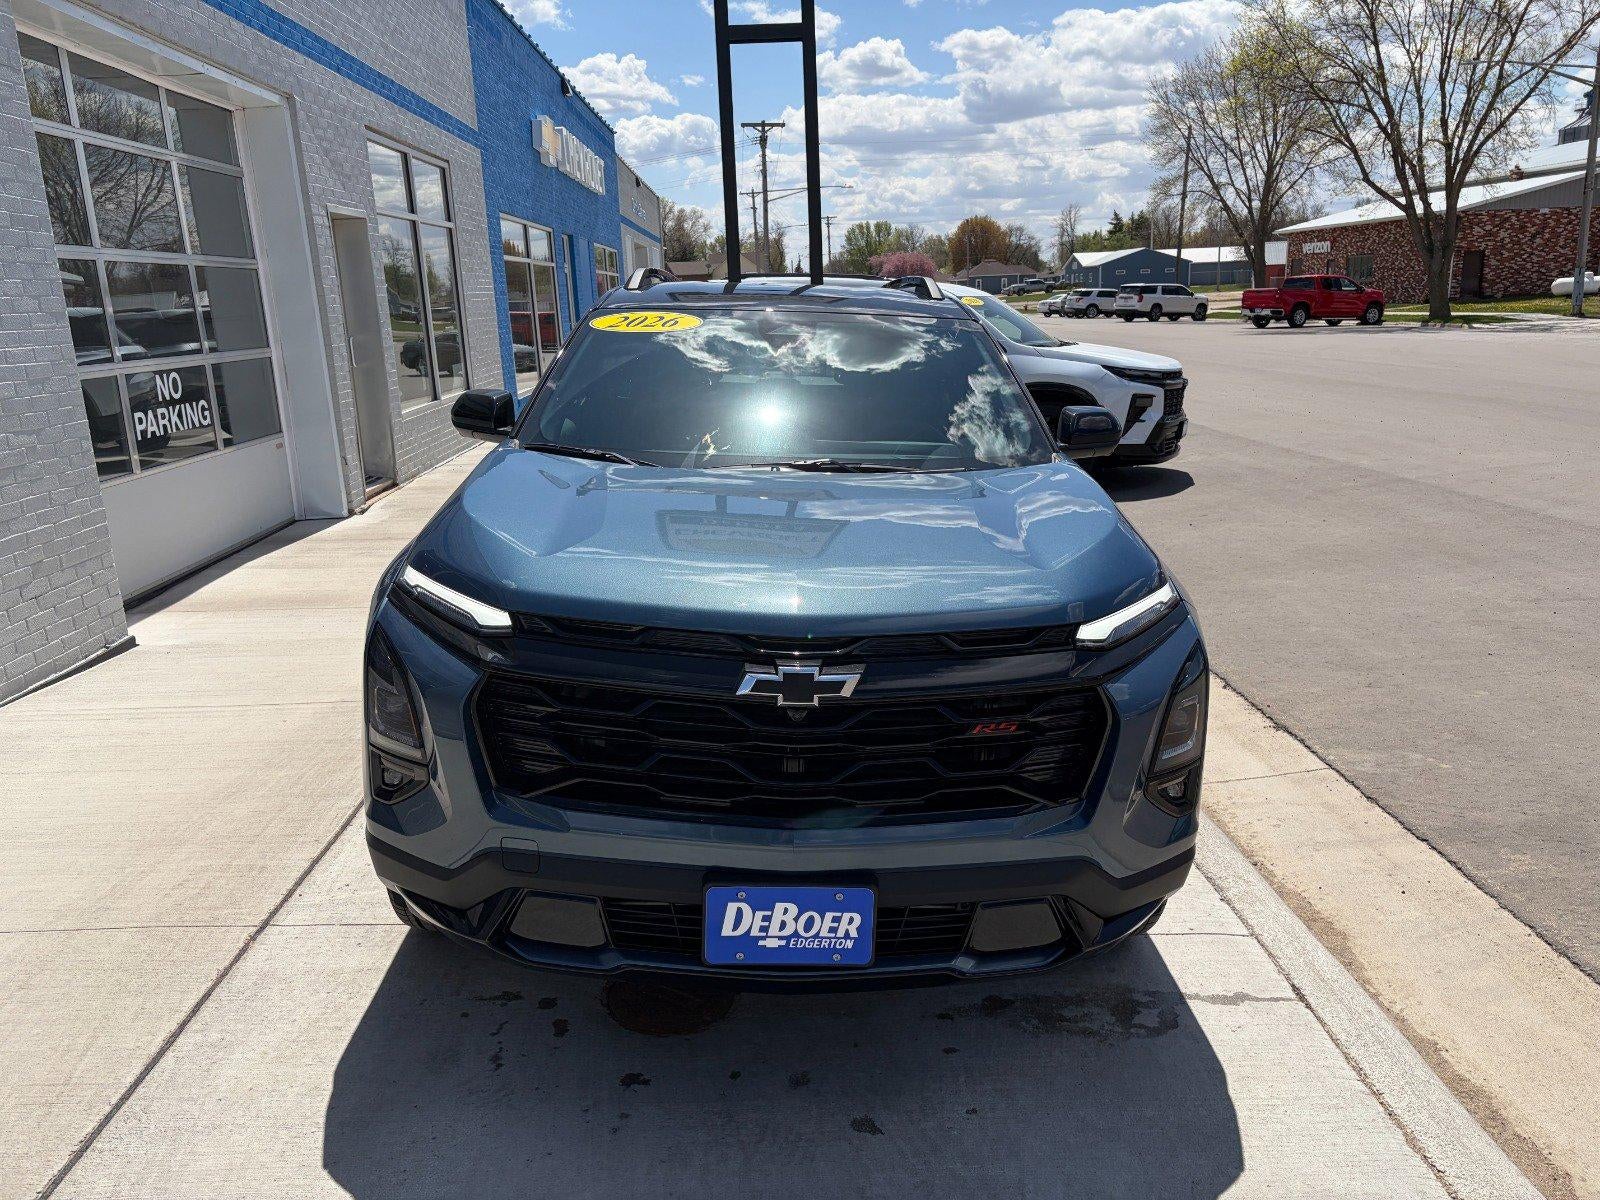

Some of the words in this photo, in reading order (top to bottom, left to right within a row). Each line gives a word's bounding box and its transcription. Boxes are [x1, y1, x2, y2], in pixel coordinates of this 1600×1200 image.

[604, 315, 684, 329] 2026
[155, 371, 183, 402] NO
[133, 399, 212, 441] PARKING
[971, 721, 1019, 736] RS
[789, 938, 855, 949] EDGERTON
